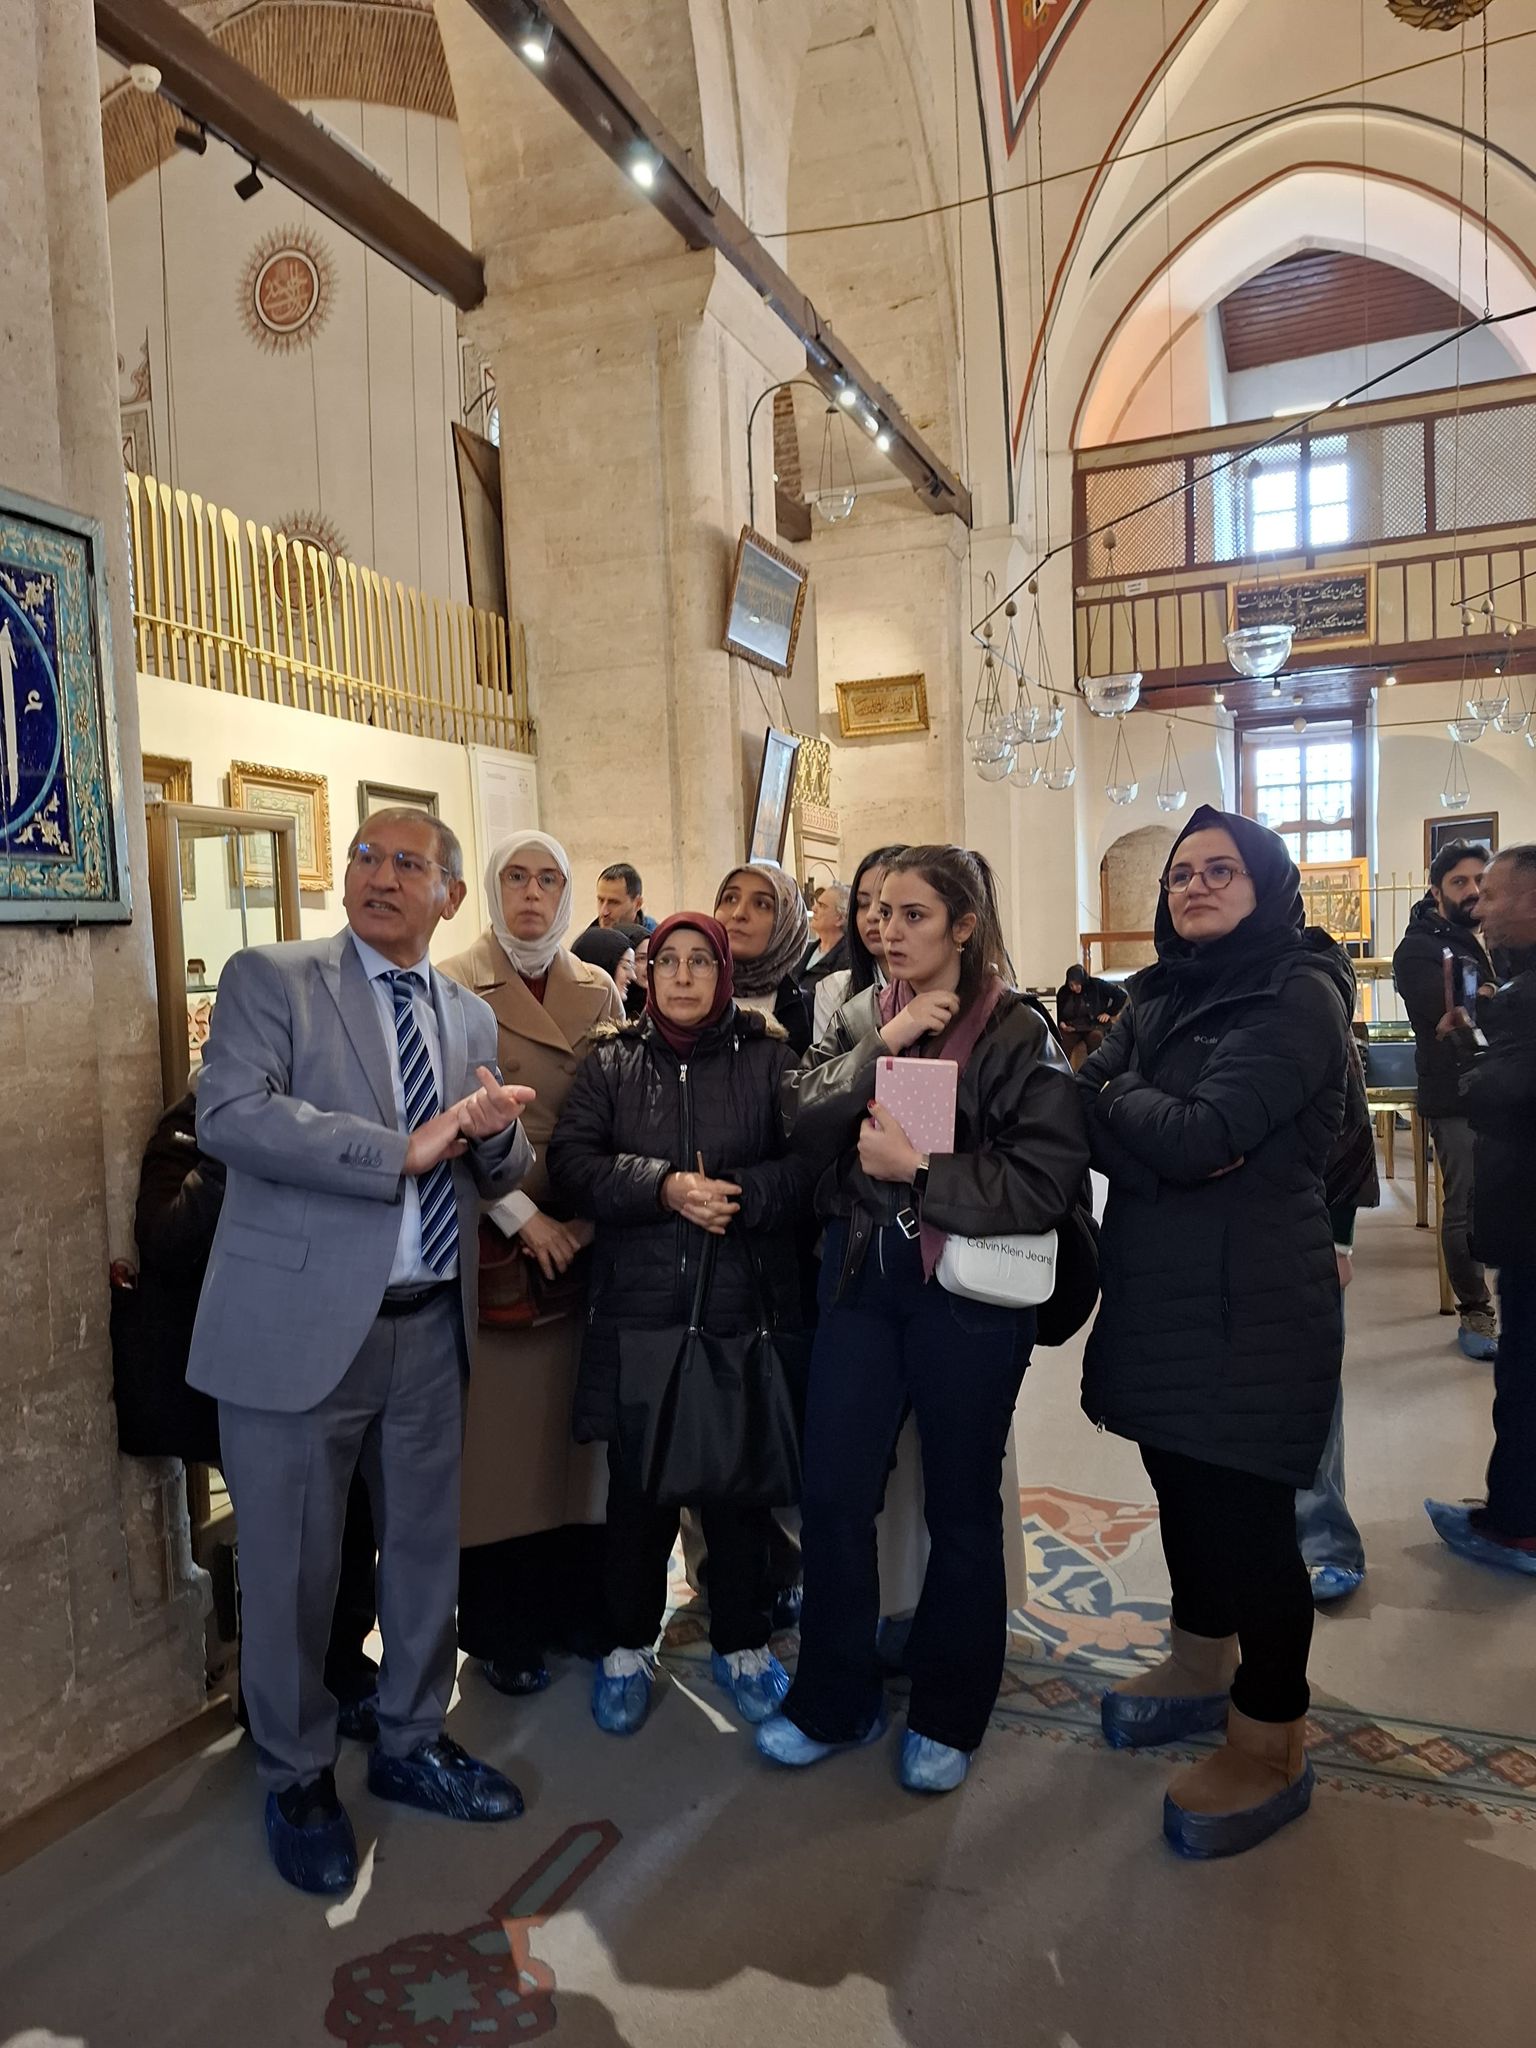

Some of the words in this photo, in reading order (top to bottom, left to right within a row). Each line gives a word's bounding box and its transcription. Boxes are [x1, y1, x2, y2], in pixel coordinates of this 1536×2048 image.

[967, 1236, 1000, 1252] Calvin
[1001, 1243, 1024, 1259] Klein
[1025, 1249, 1053, 1266] Jeans
